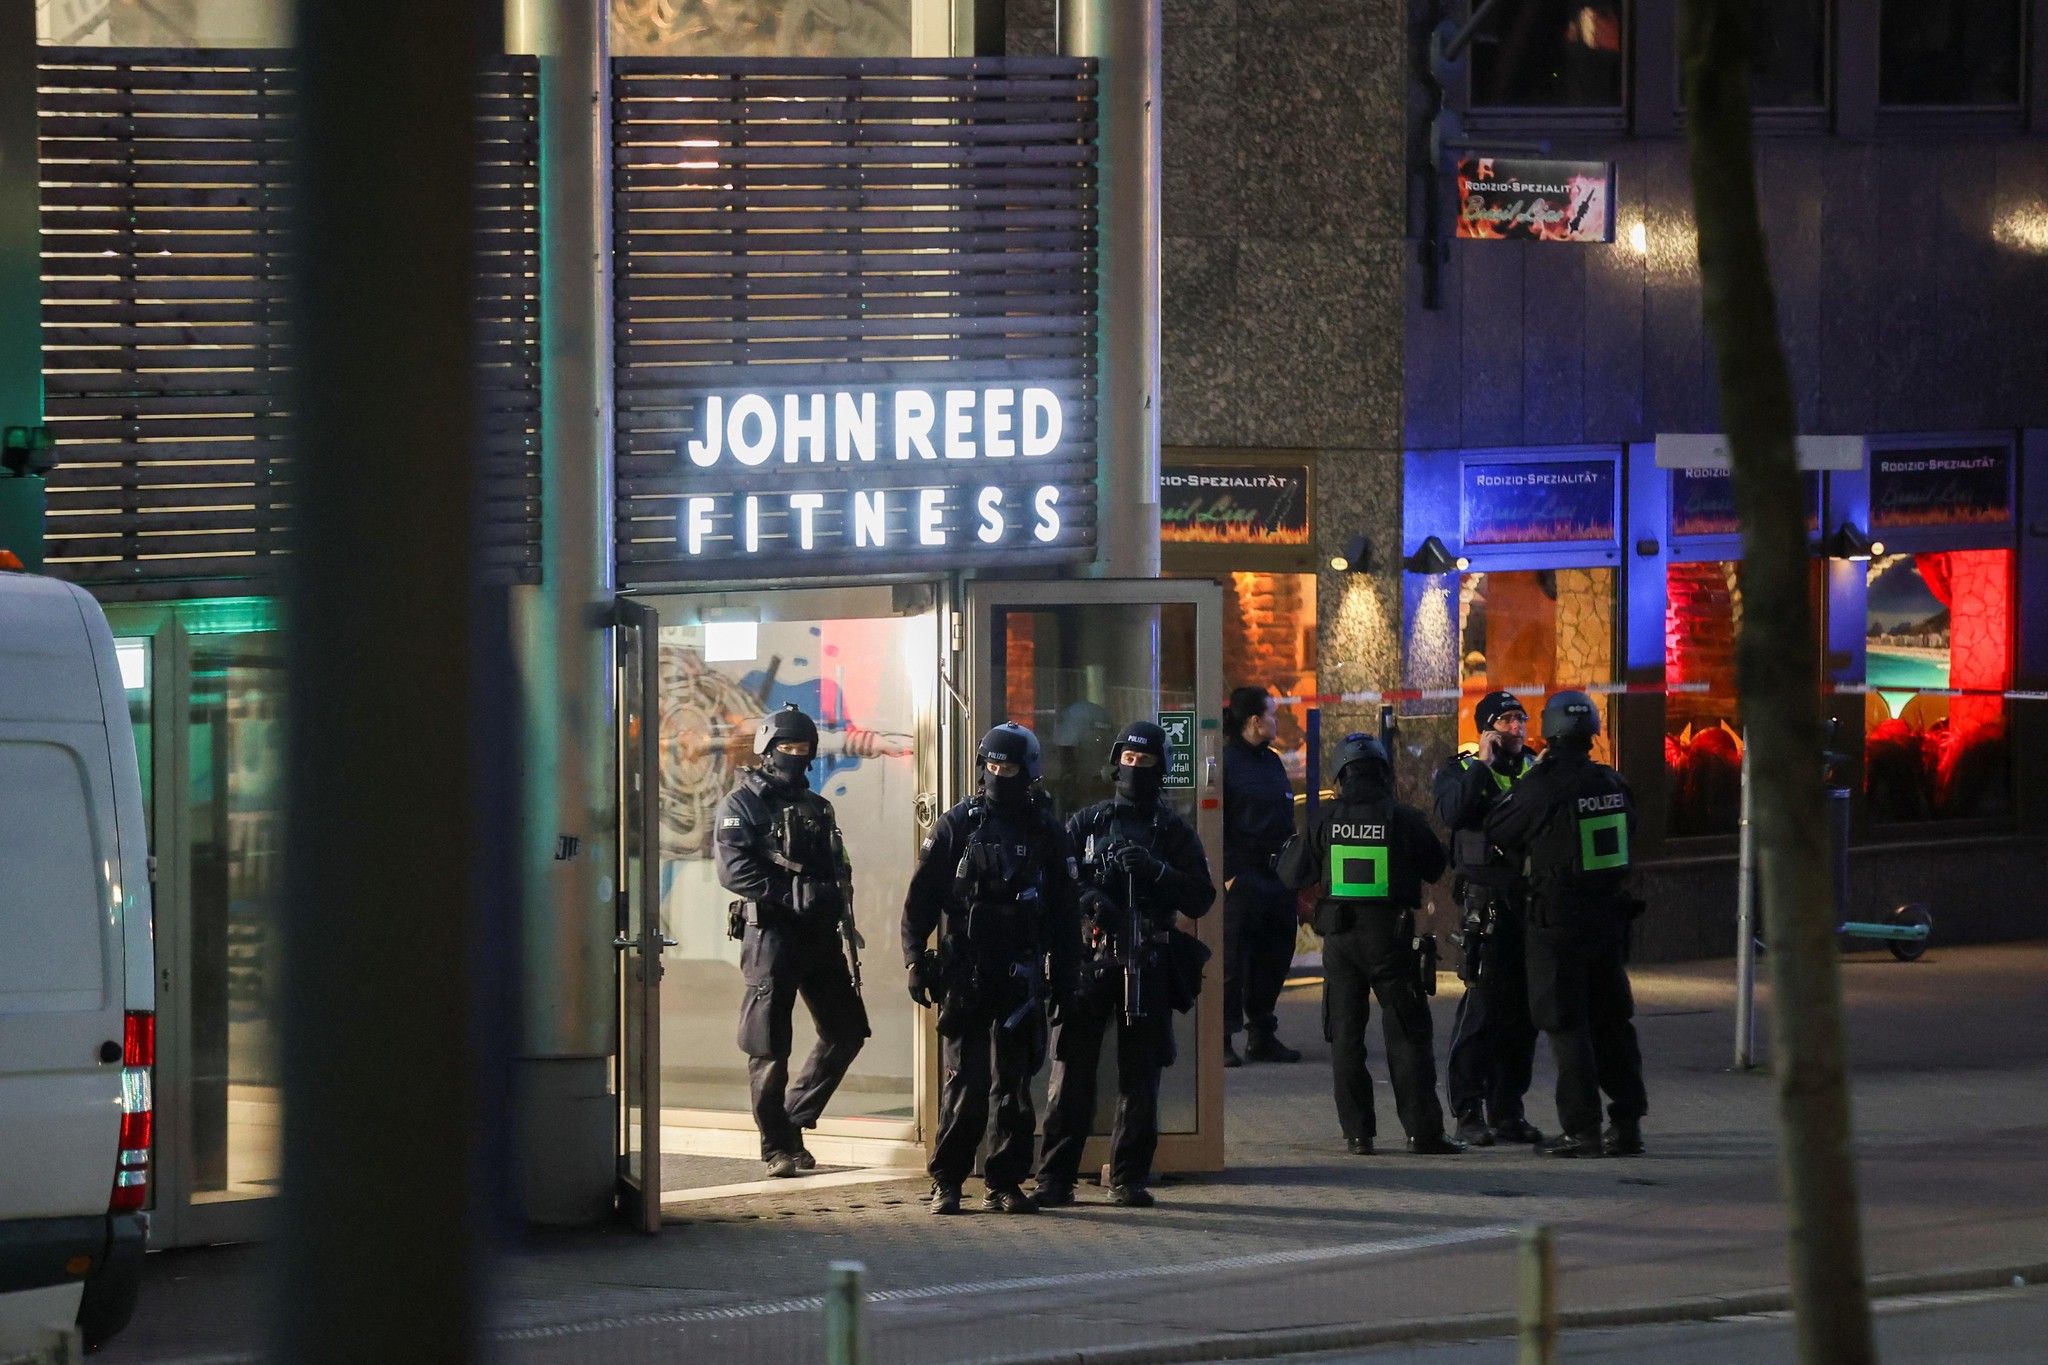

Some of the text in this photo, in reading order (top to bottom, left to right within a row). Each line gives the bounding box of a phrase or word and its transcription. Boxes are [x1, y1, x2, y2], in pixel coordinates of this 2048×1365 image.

[688, 388, 1063, 467] JOHN REED
[688, 486, 1061, 555] FITNESS
[1128, 734, 1148, 744] POLIZEI
[988, 751, 1007, 760] POLIZEI
[1578, 793, 1624, 813] POLIZEI
[1332, 823, 1385, 839] POLIZEI
